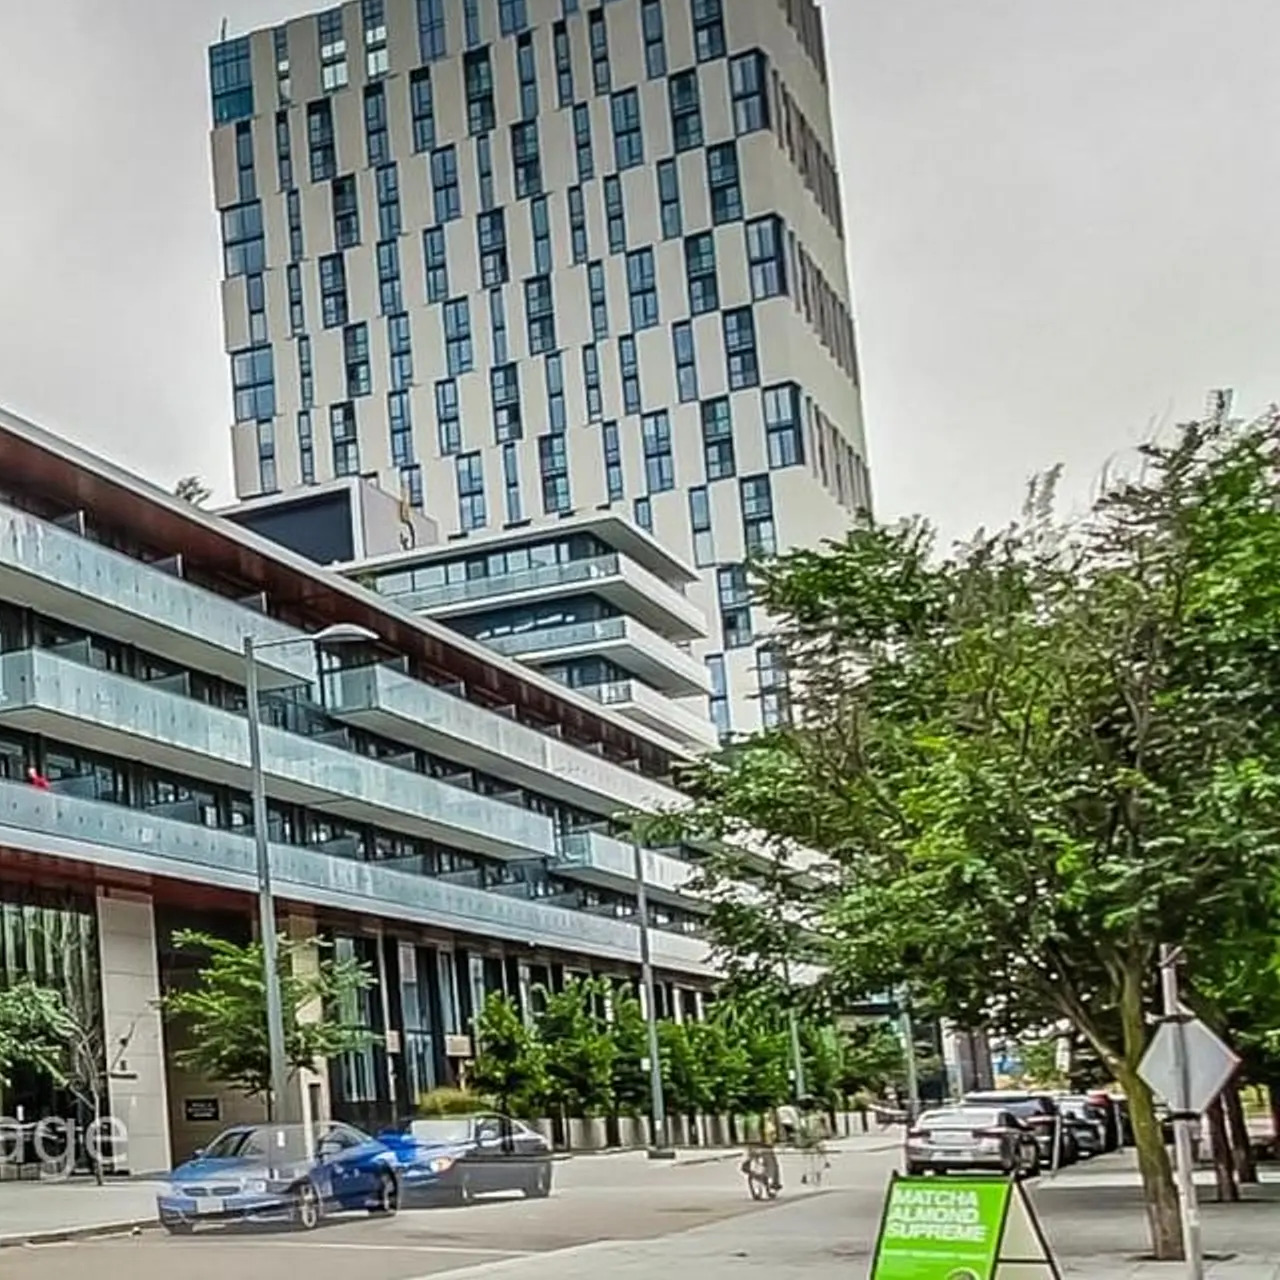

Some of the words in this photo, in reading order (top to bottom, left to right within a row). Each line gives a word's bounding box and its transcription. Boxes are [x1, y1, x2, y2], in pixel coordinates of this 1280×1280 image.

[893, 1188, 979, 1207] MATCHA
[890, 1206, 980, 1223] ALMOND
[888, 1222, 986, 1242] SUPREME
